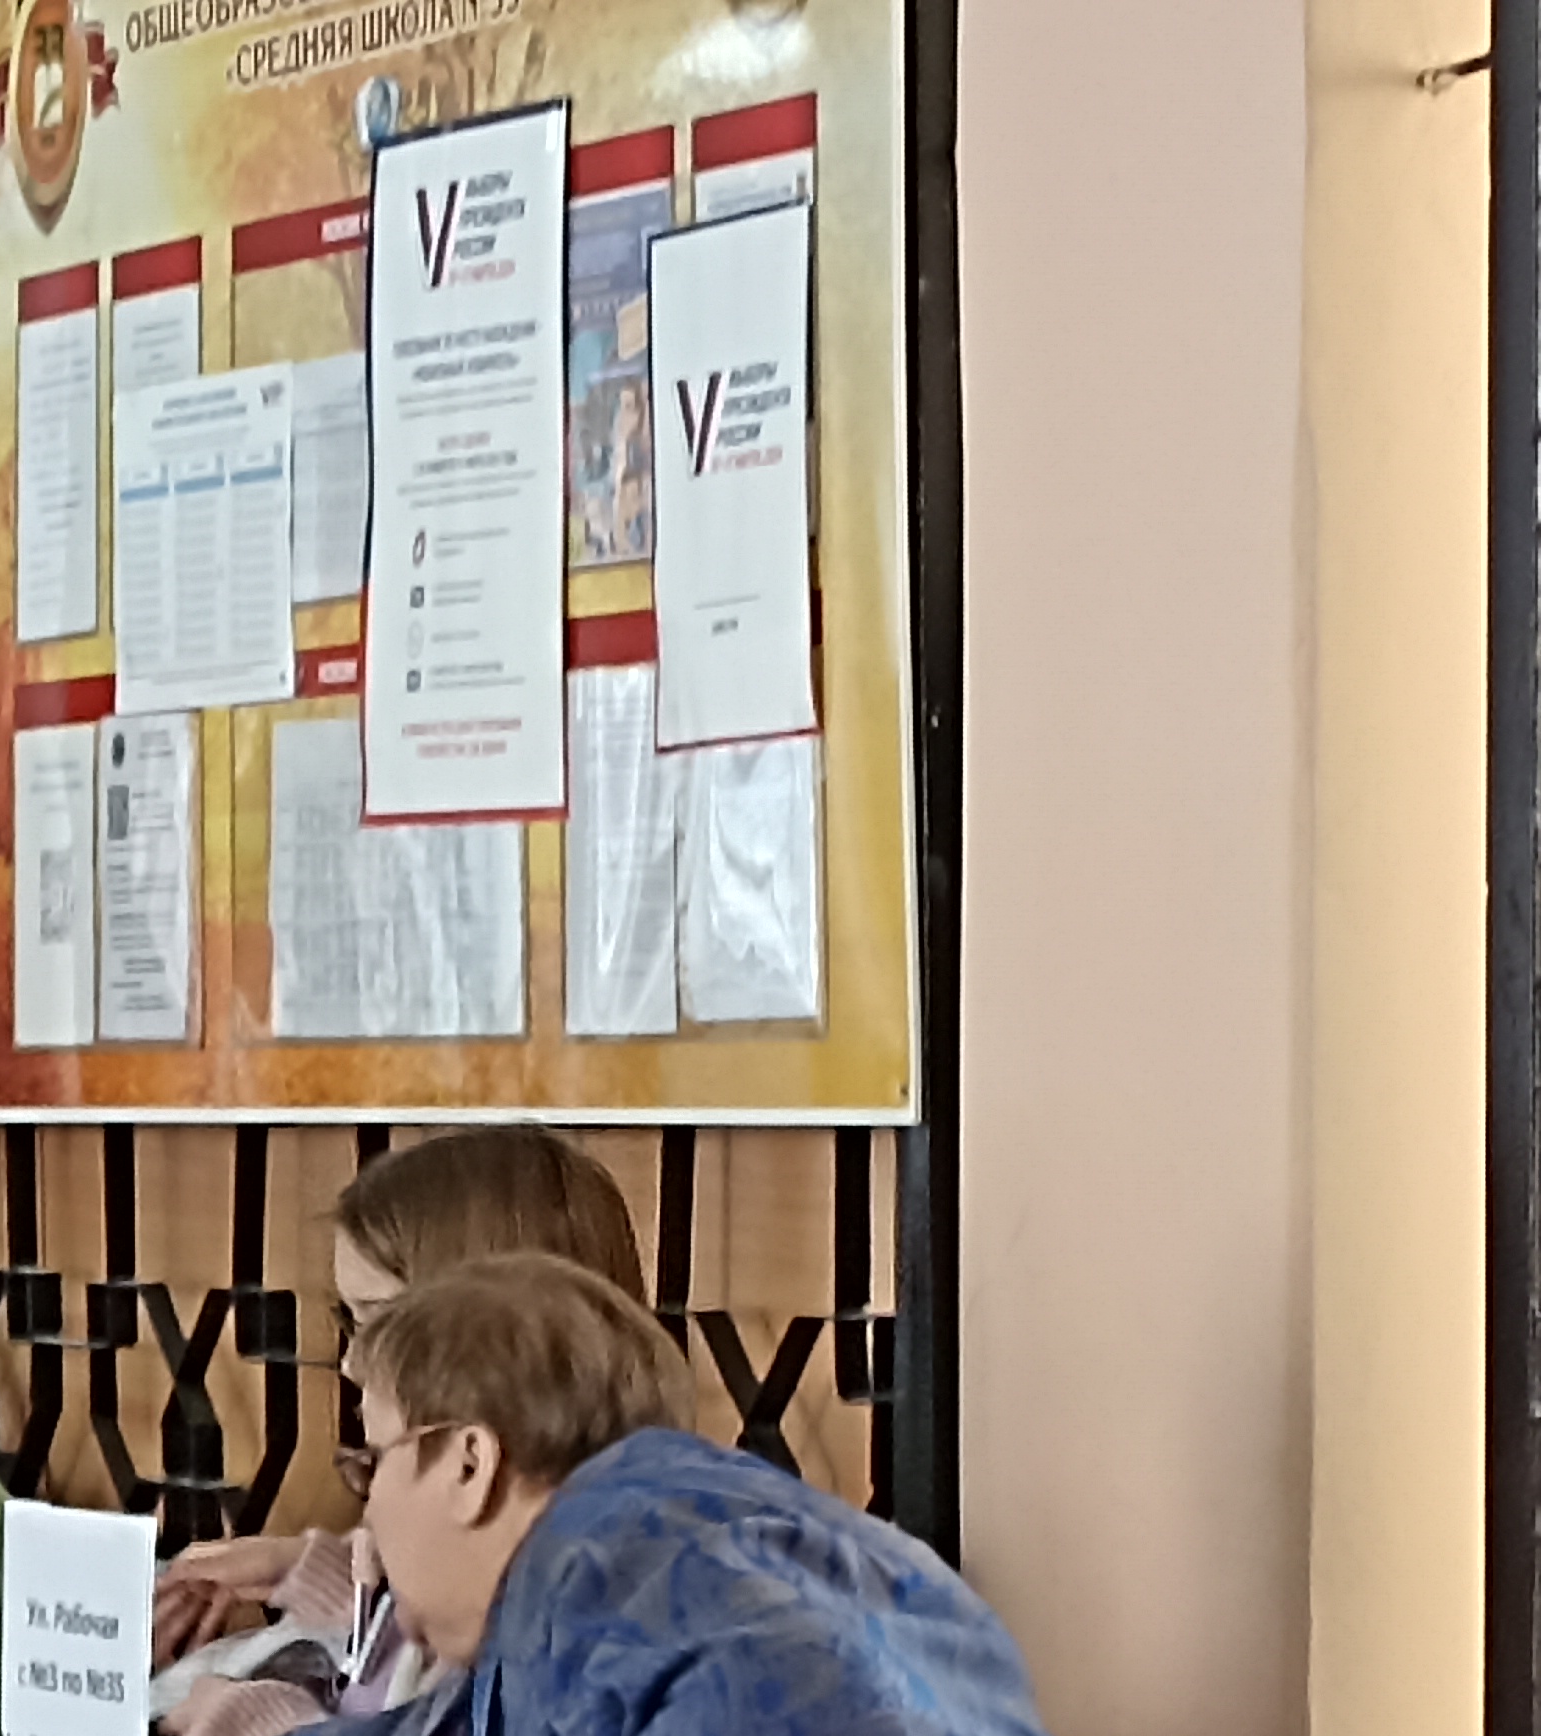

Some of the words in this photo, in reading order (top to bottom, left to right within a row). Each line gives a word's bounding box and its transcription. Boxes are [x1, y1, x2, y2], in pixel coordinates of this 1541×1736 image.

[361, 0, 454, 53] ШКОЛА
[25, 1598, 49, 1628] Ул.
[53, 1602, 119, 1639] Рабочая
[29, 1661, 58, 1691] №3
[61, 1670, 83, 1694] по
[86, 1668, 124, 1702] №35
